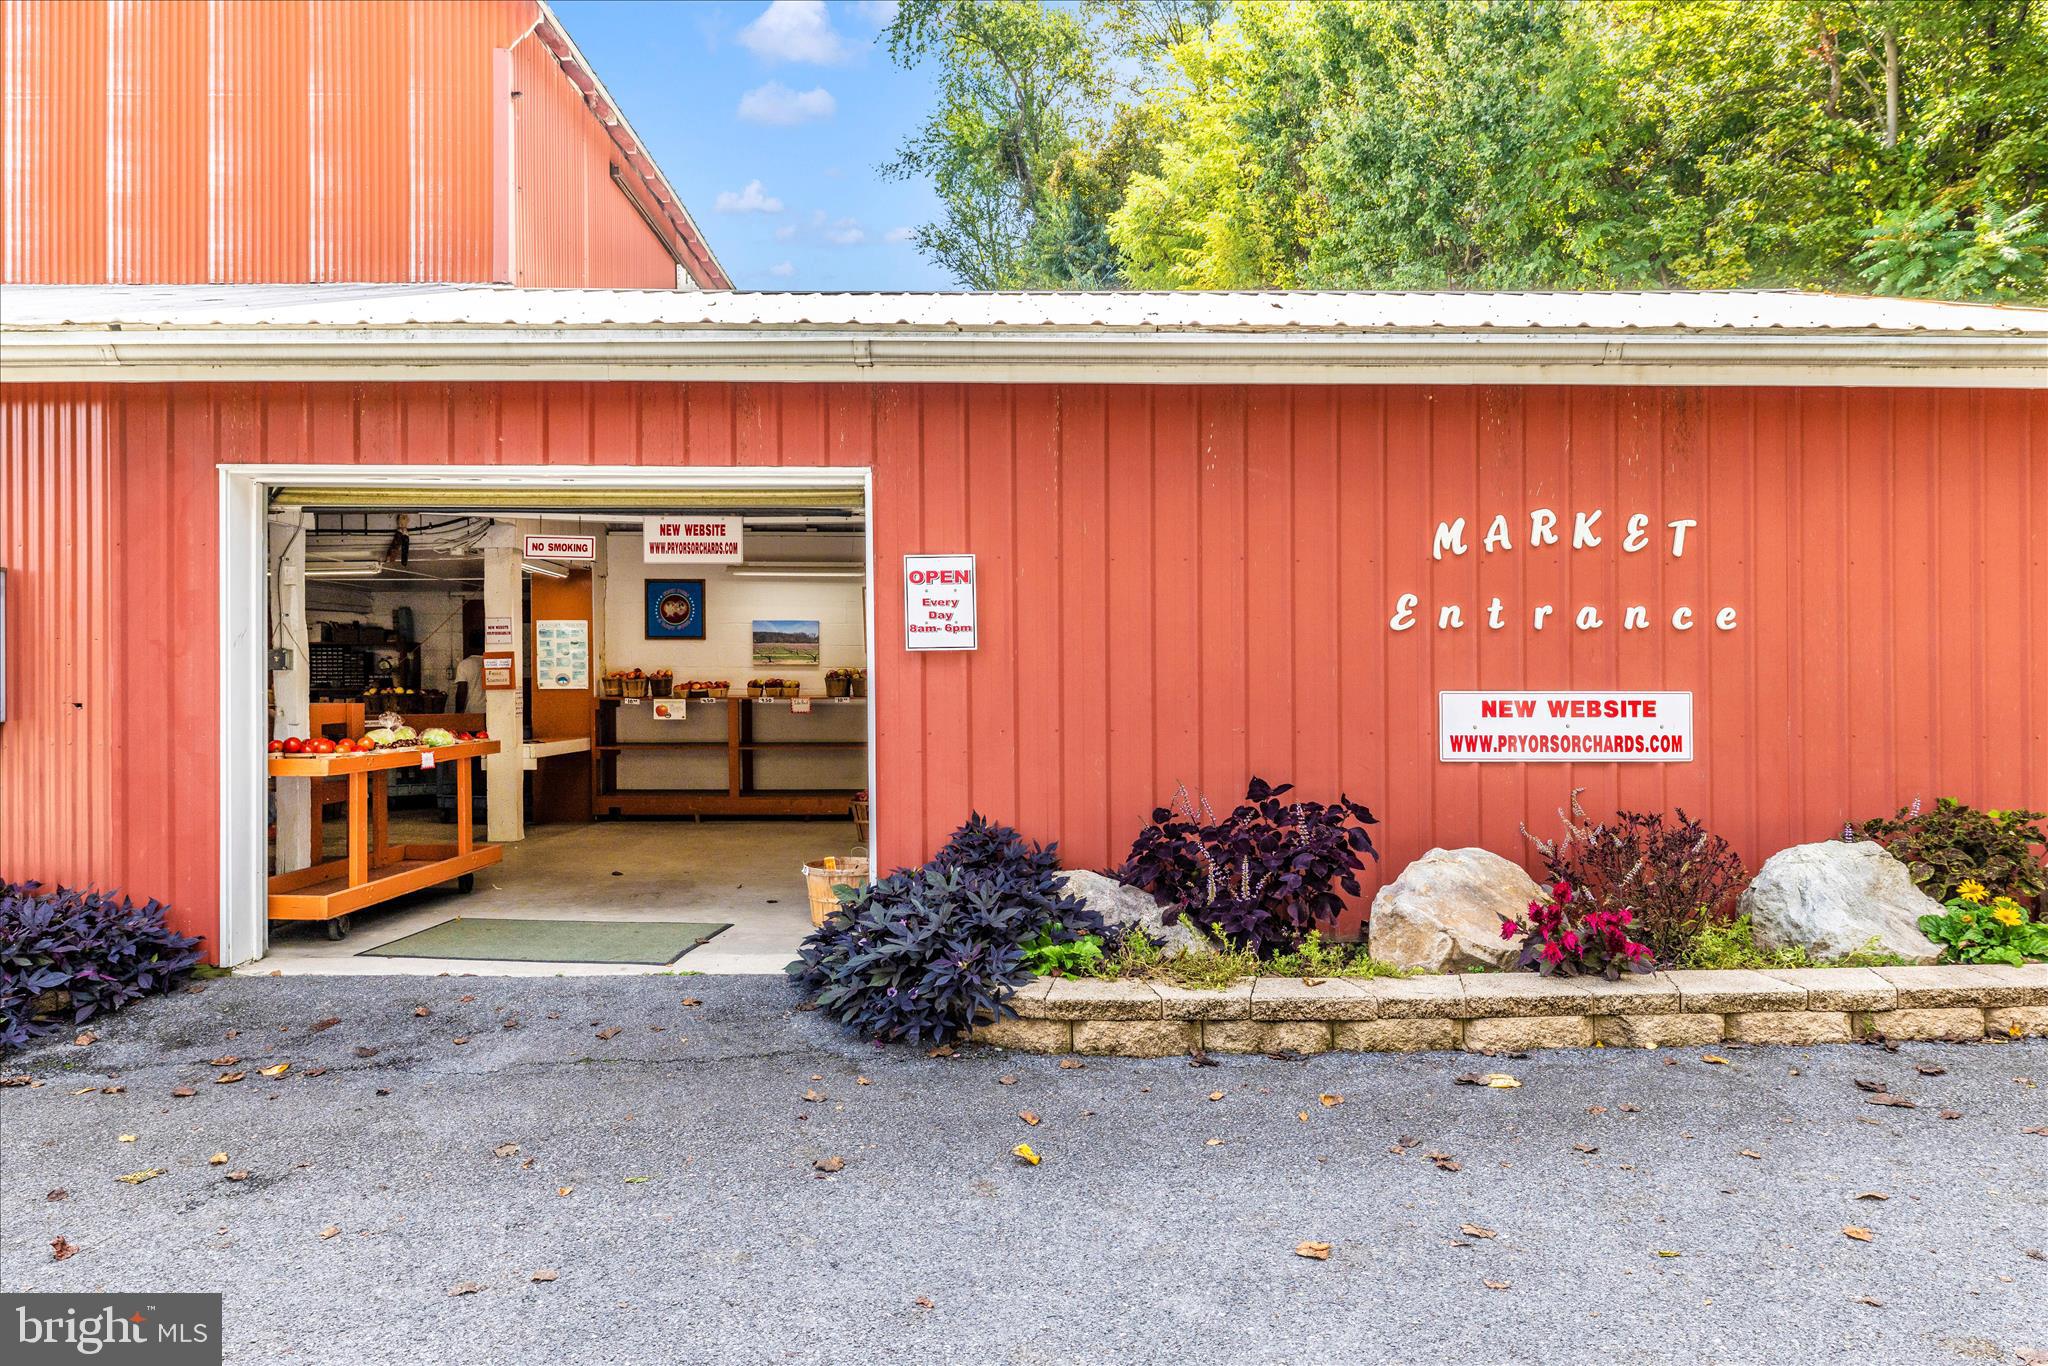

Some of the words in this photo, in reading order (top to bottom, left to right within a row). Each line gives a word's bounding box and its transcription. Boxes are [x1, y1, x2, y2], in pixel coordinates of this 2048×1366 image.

[660, 524, 681, 536] NEW
[684, 524, 726, 536] WEBSITE
[1433, 508, 1697, 560] MARKET
[532, 543, 544, 551] NO
[548, 543, 588, 552] SMOKING
[649, 542, 738, 554] WWW.PRYORSORCHARDS.COM
[909, 570, 971, 585] OPEN
[922, 598, 959, 608] Every
[928, 611, 954, 621] Day
[1389, 593, 1737, 631] Entrance
[944, 623, 972, 634] 6pm
[1481, 700, 1537, 718] NEW
[1547, 700, 1657, 718] WEBSITE
[1450, 735, 1683, 753] WWW.PRYORSORCHARDS.COM
